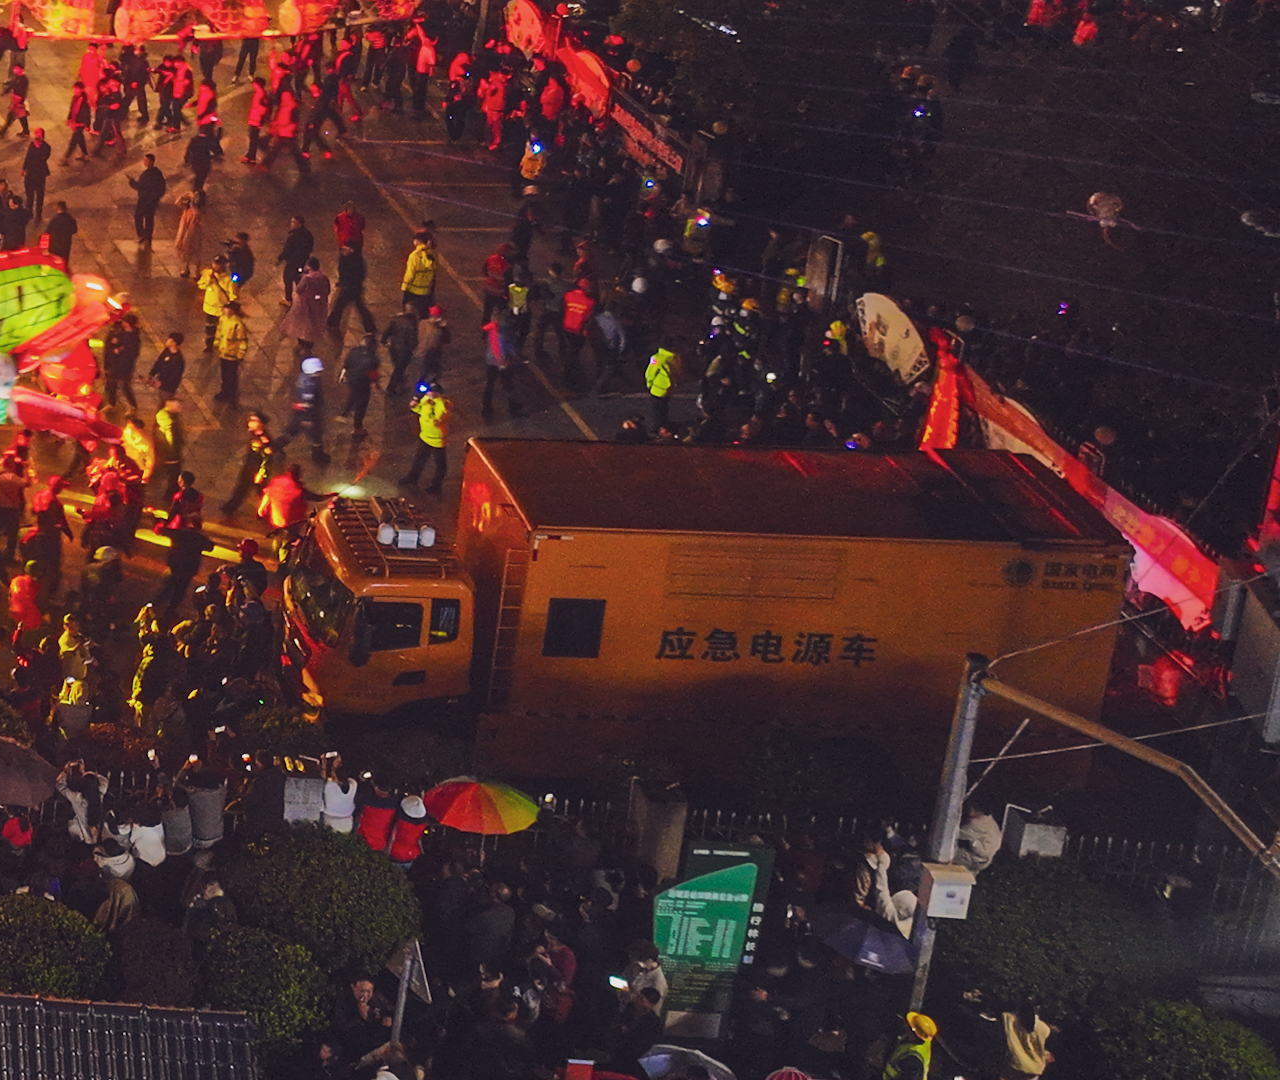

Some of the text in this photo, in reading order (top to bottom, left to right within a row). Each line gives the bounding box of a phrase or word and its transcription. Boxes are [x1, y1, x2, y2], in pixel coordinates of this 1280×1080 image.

[655, 627, 879, 667] 应急电源车
